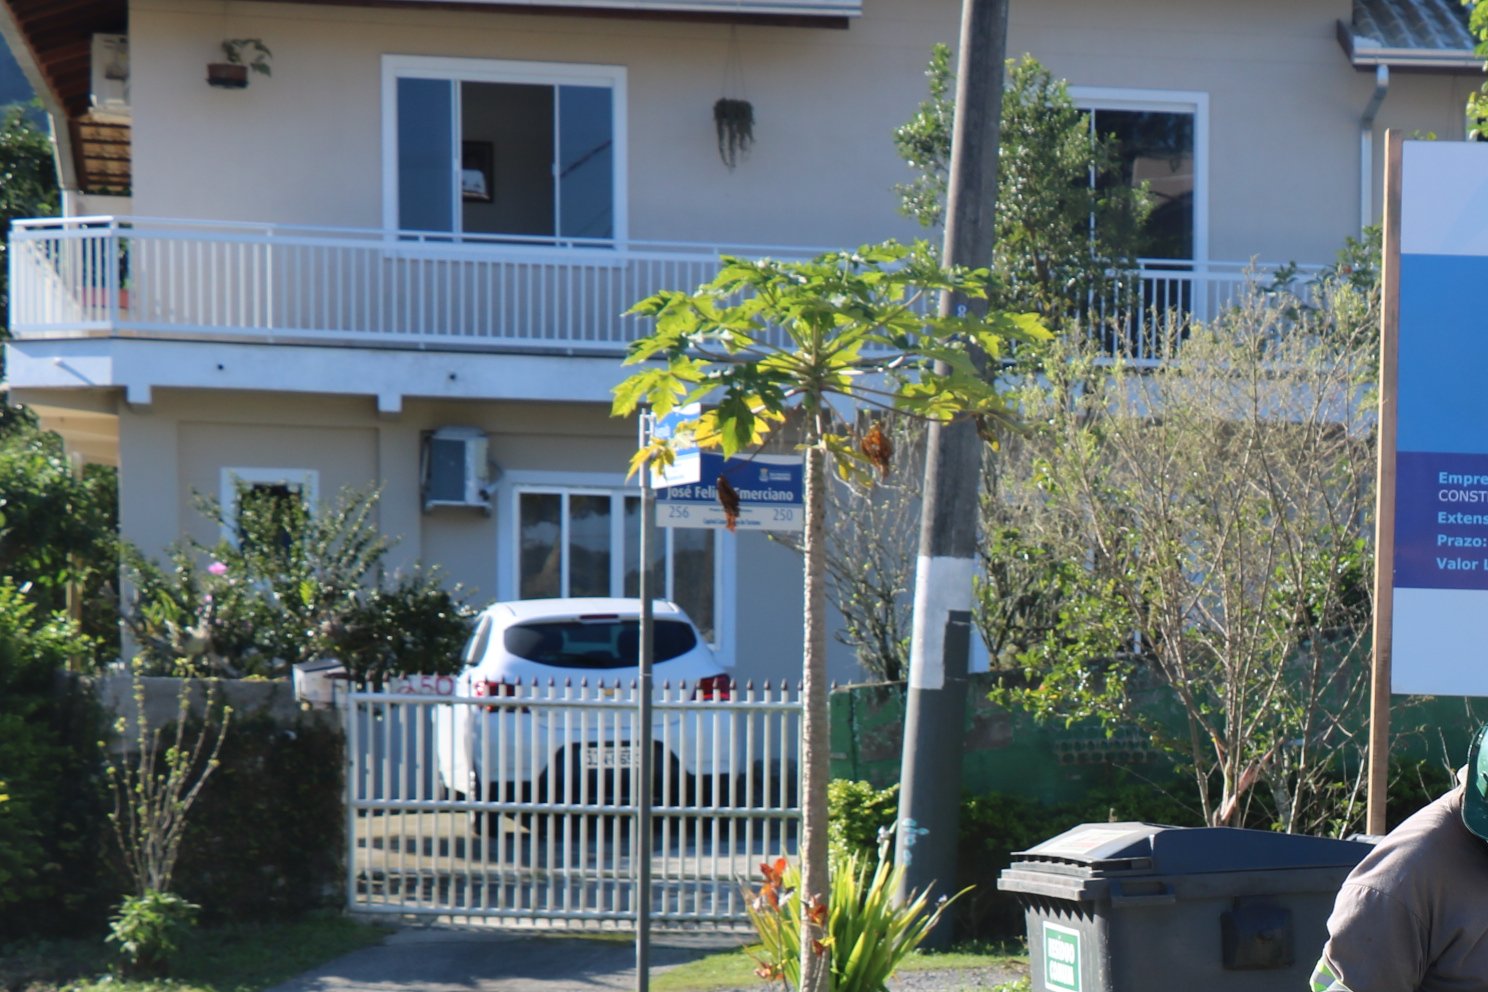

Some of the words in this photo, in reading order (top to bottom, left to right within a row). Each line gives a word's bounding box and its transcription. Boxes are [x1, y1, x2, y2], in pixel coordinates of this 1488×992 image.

[667, 485, 692, 499] José
[669, 505, 690, 518] 256
[773, 508, 793, 521] 250
[1437, 534, 1487, 548] Prazo:
[1436, 557, 1479, 571] Valor
